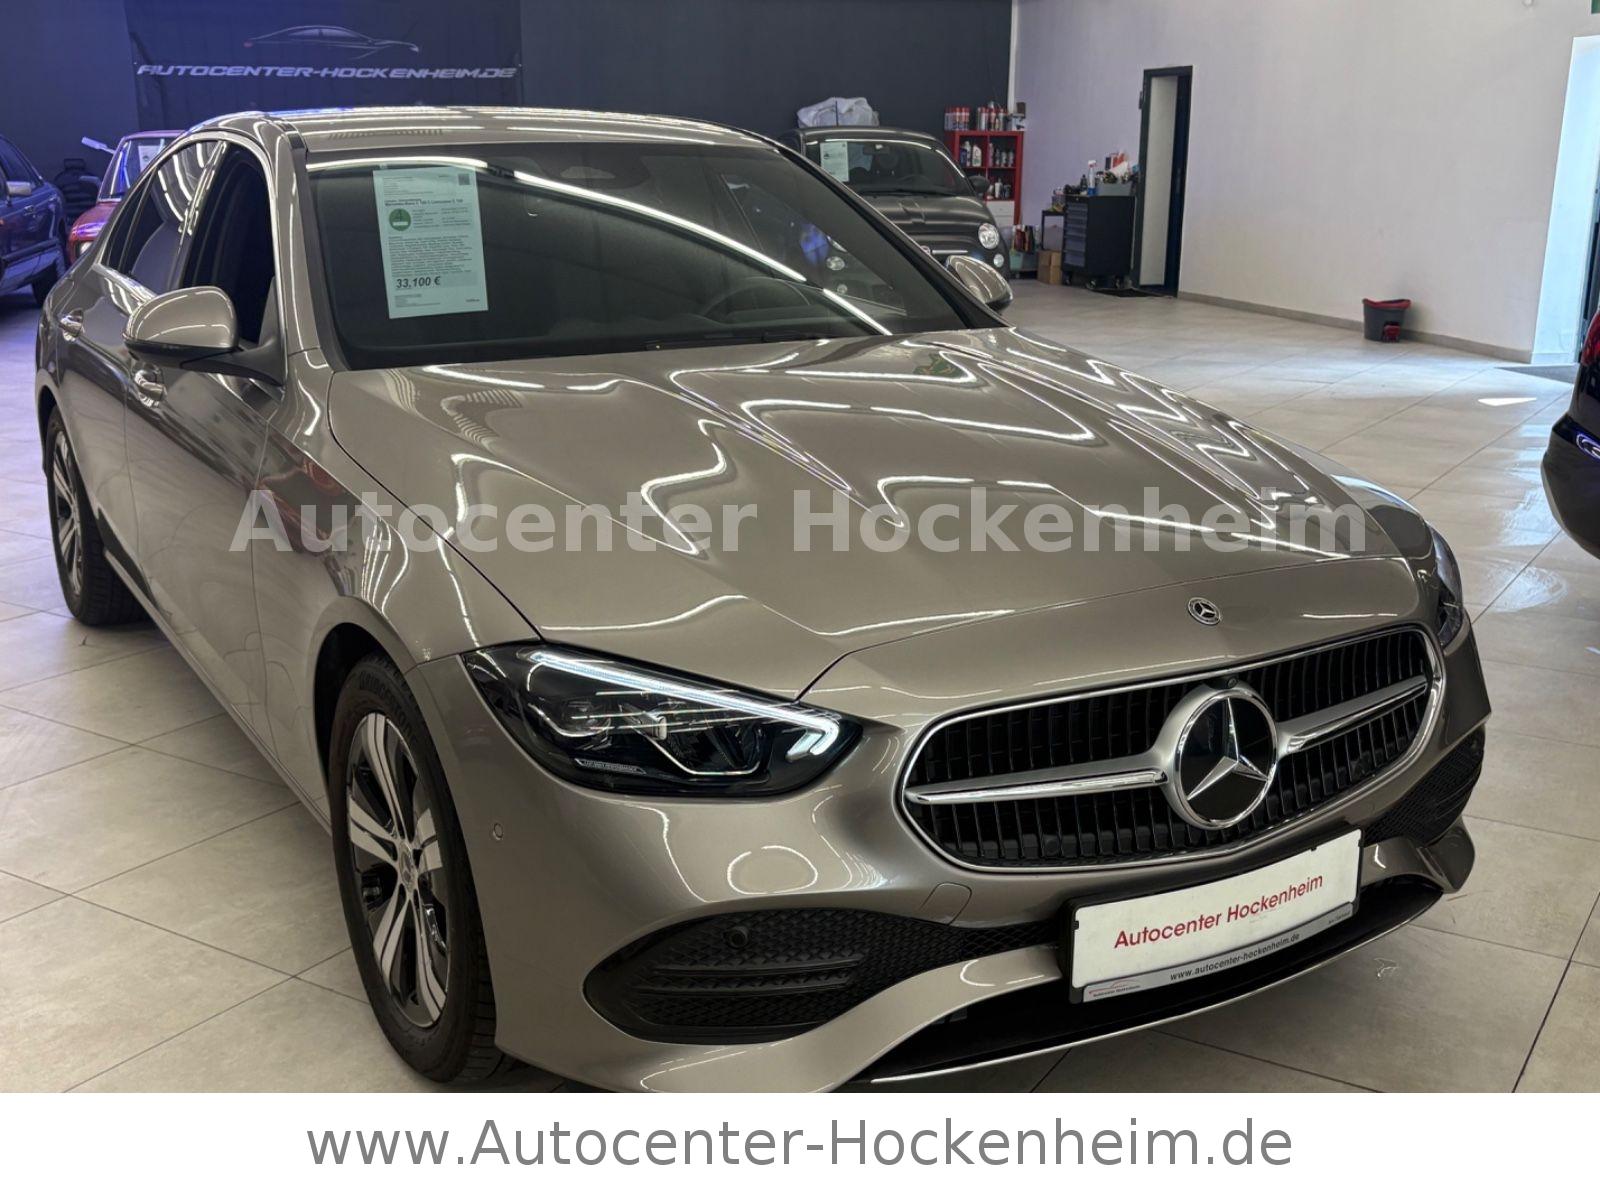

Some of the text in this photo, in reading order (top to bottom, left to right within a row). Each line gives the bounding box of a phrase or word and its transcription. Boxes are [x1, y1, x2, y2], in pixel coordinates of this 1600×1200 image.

[136, 64, 518, 80] AUTOCENTER-HOCKENHEIM.DE
[396, 276, 441, 289] 33.100 €
[1114, 874, 1324, 949] Autocenter Hockenheim
[1169, 933, 1301, 983] www.autocenter-hockenheim.de
